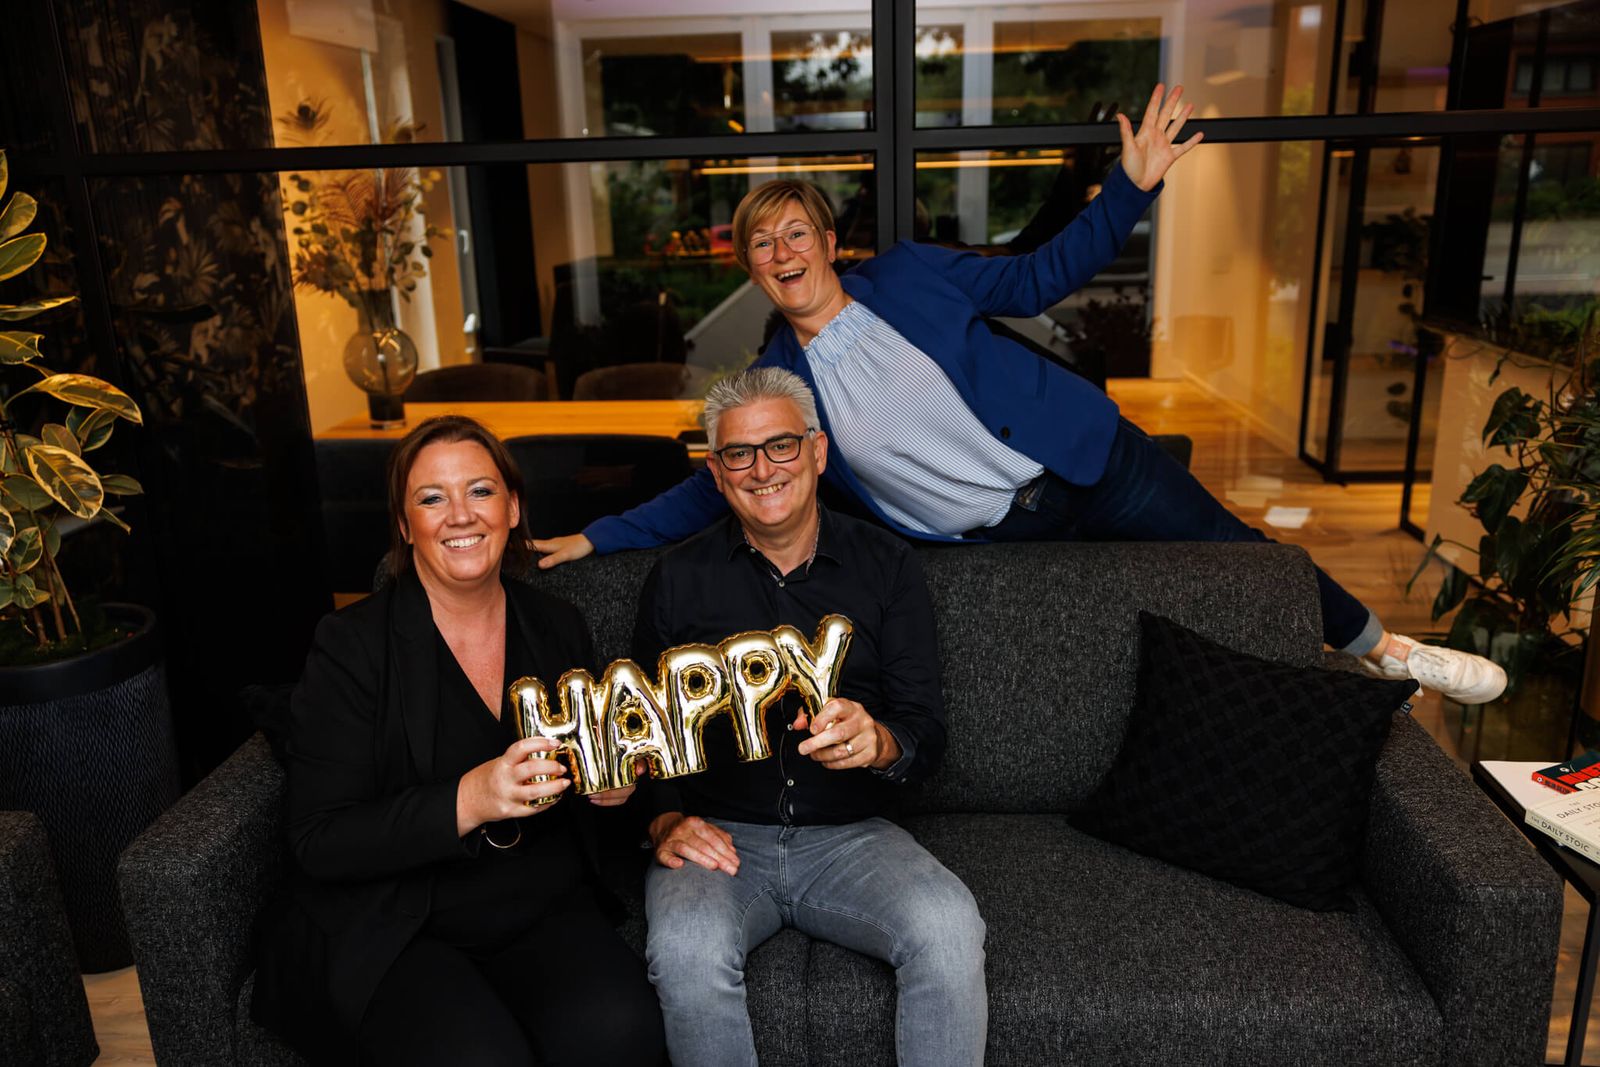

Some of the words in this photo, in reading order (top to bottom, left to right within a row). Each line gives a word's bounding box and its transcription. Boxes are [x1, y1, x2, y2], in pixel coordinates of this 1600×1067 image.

[508, 613, 854, 808] HAPPY
[1556, 807, 1583, 819] DAILY
[1541, 820, 1563, 837] DAILY
[1565, 834, 1590, 853] STOIC
